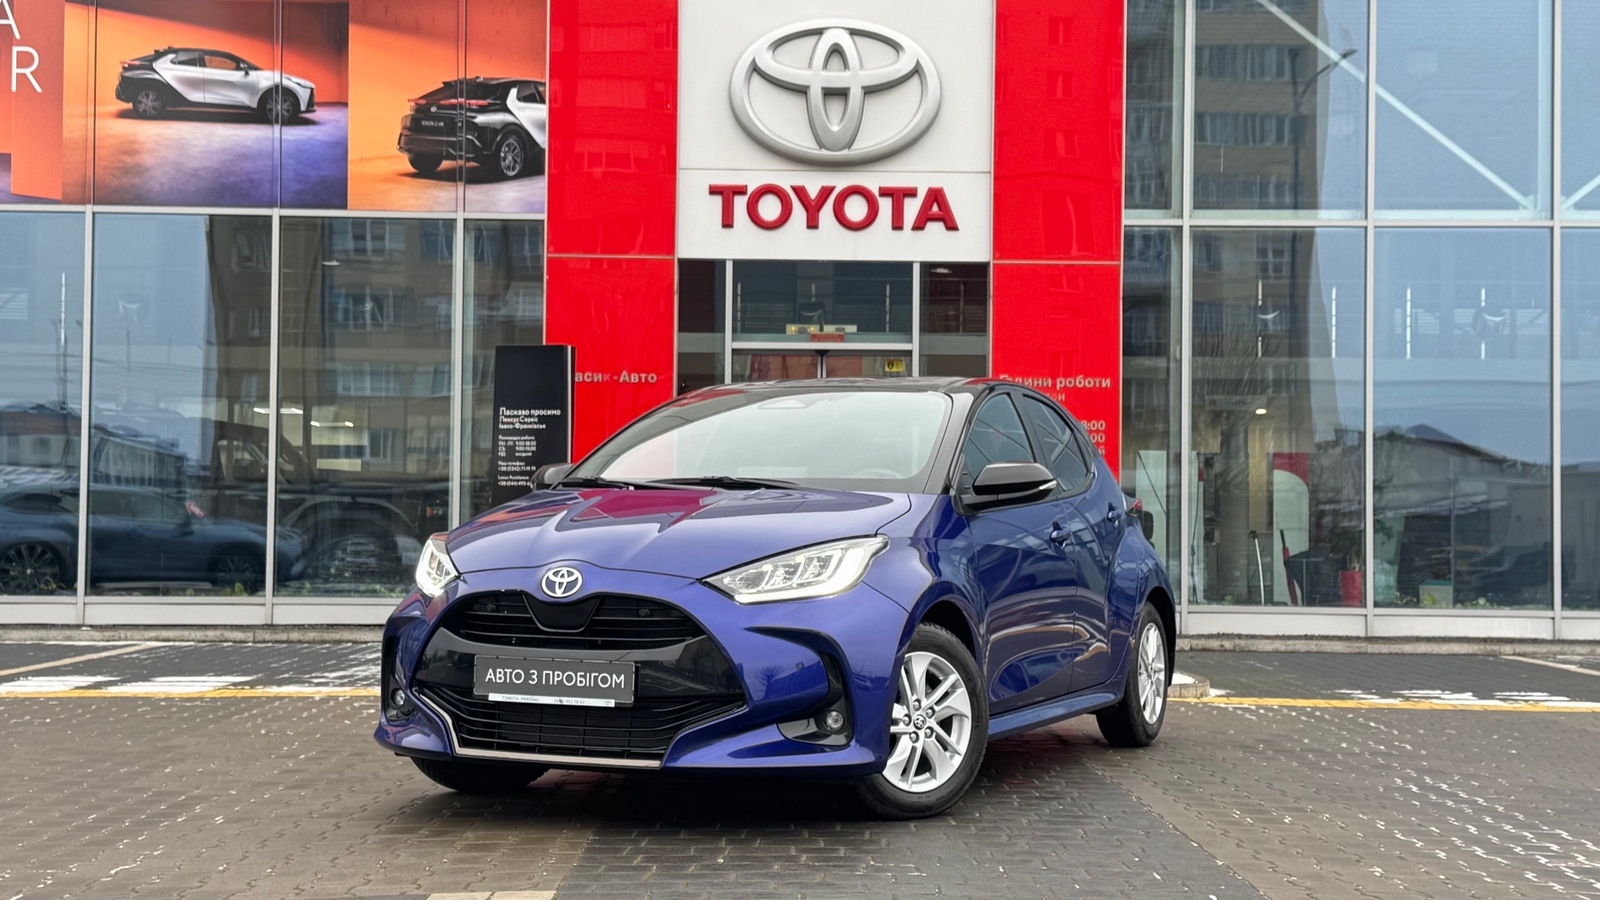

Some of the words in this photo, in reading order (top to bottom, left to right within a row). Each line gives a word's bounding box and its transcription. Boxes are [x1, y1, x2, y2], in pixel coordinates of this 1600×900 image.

[709, 183, 960, 231] TOYOTA
[1056, 375, 1111, 391] роботи
[485, 668, 525, 684] АВТО
[528, 670, 538, 685] З
[542, 671, 625, 689] ПРОБІГОМ
